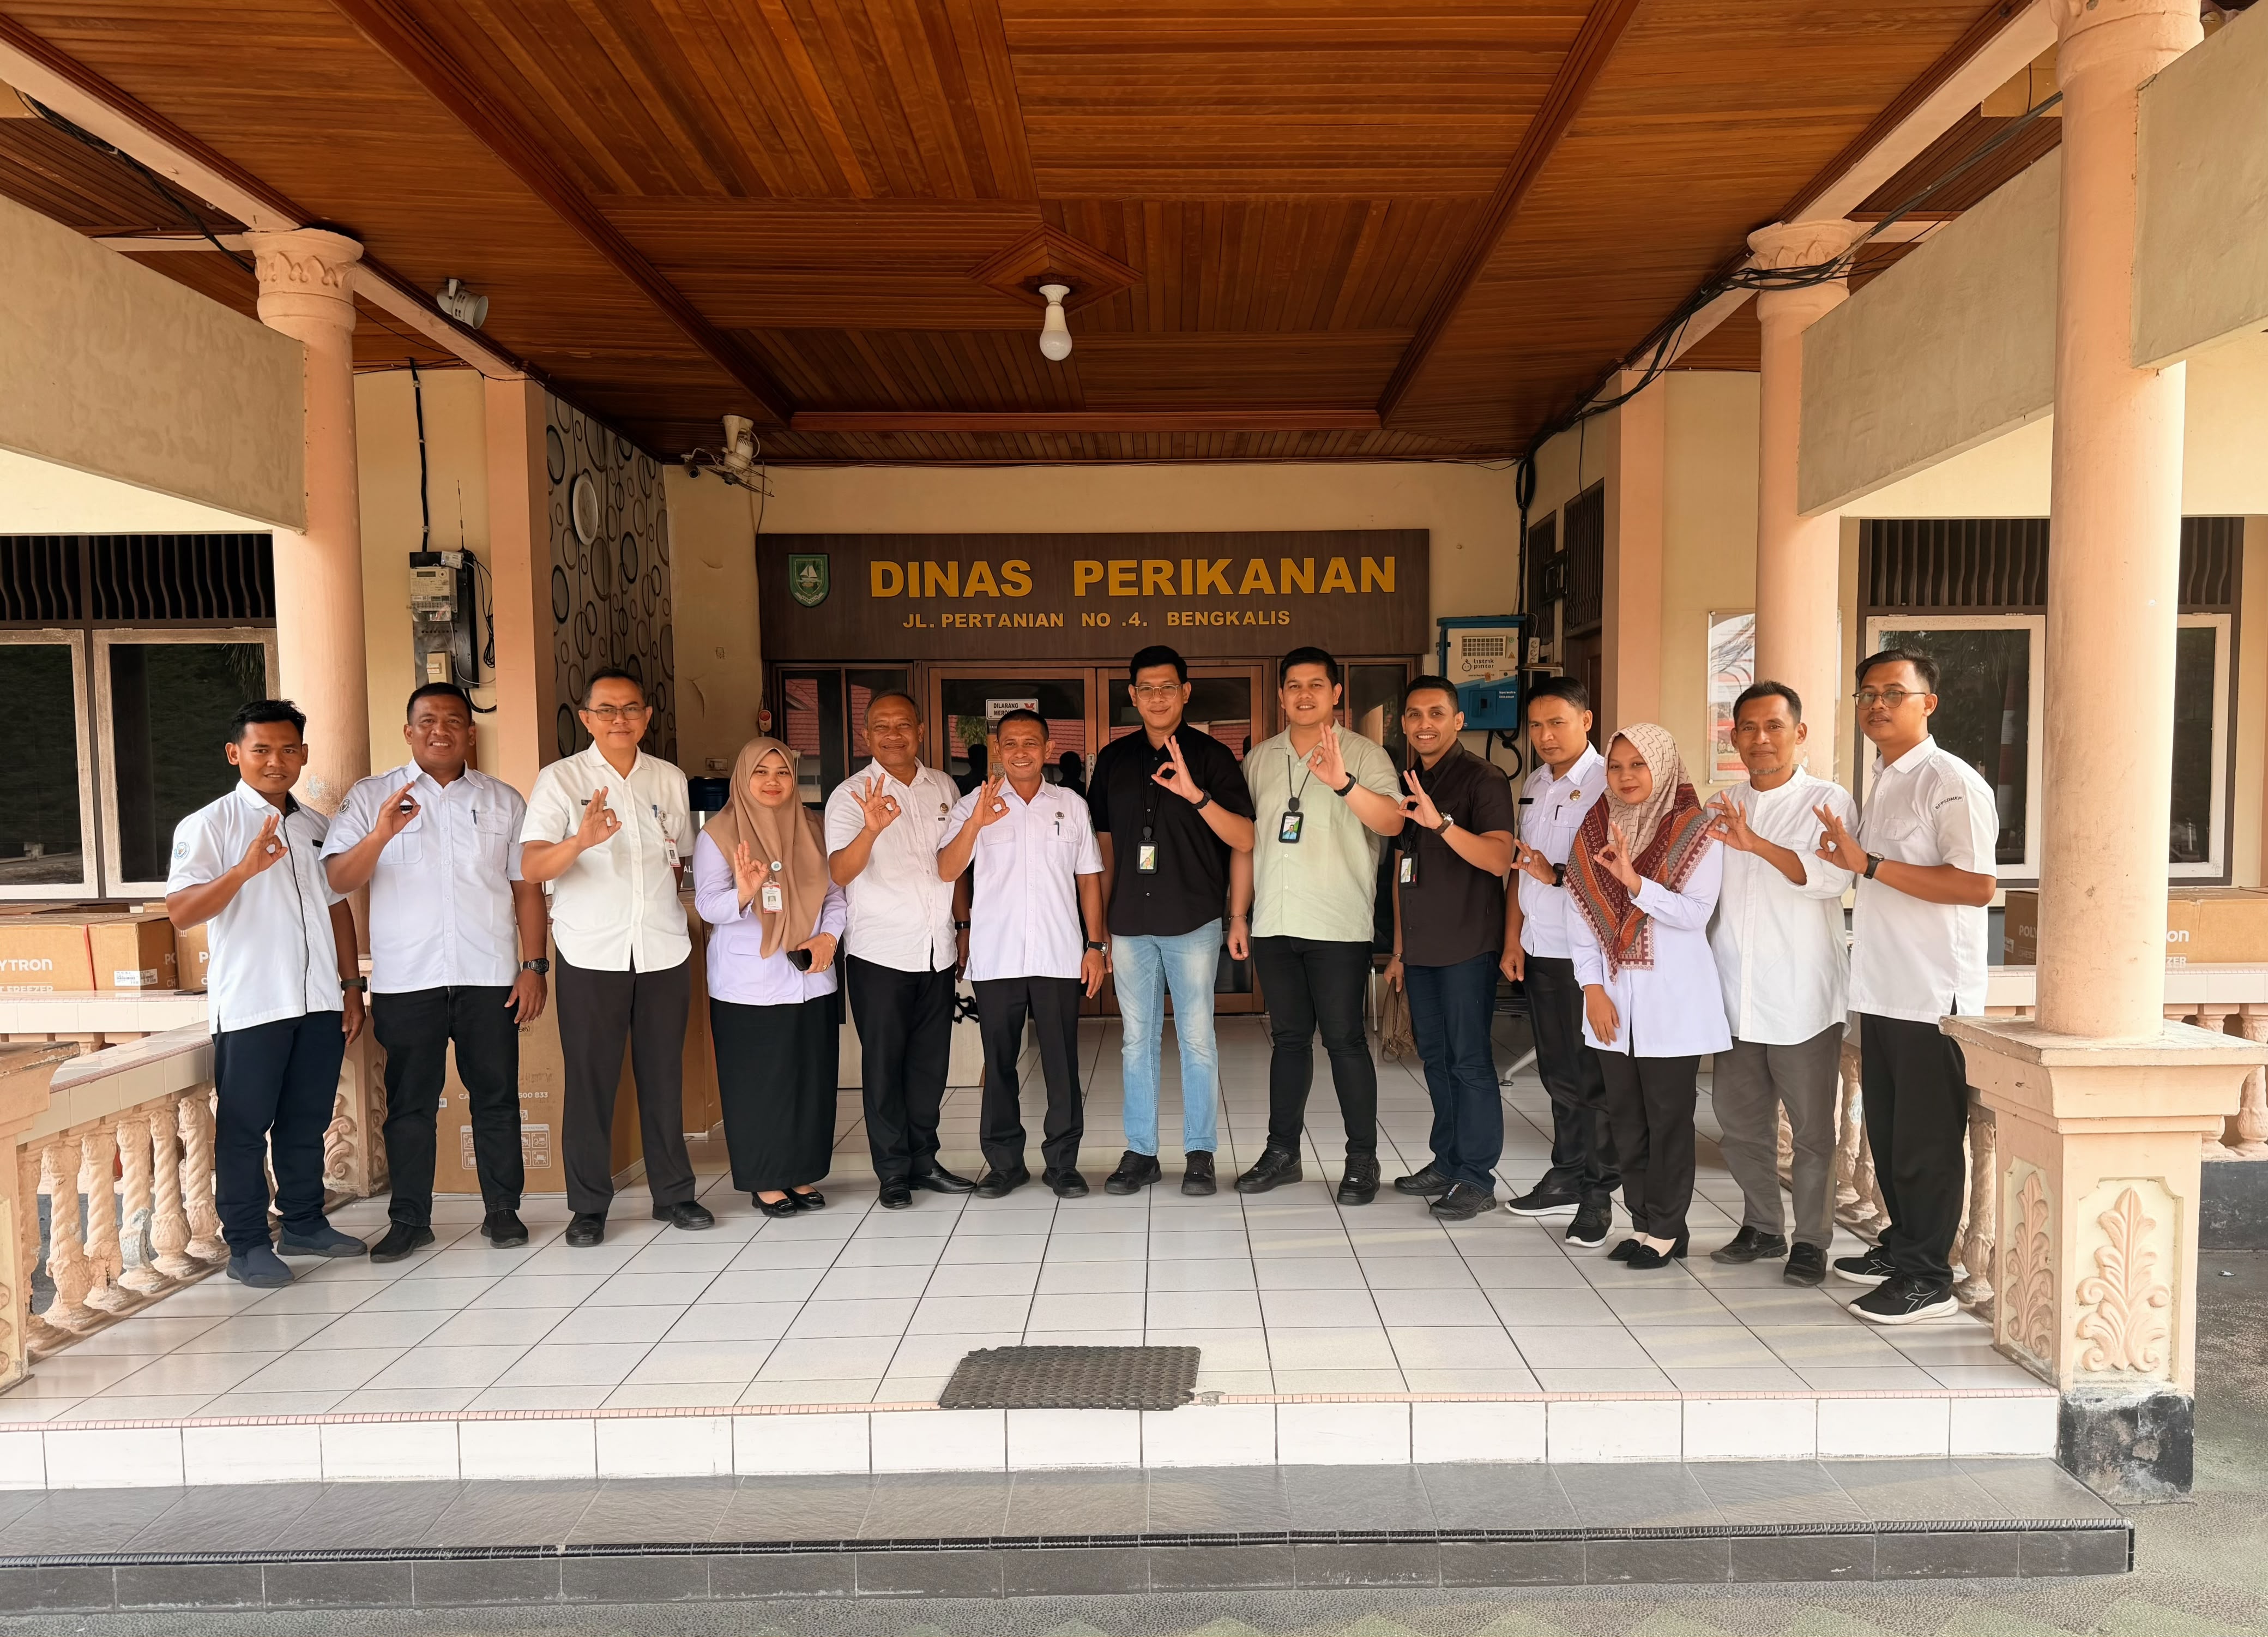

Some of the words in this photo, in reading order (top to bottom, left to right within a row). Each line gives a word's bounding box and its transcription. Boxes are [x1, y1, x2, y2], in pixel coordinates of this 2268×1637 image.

[871, 559, 1033, 598] DINAS
[1073, 556, 1396, 597] PERIKANAN
[903, 613, 935, 628] JL.
[942, 613, 1064, 628] PERTANIAN
[1082, 612, 1111, 627] NO
[1167, 610, 1291, 626] BENGKALIS
